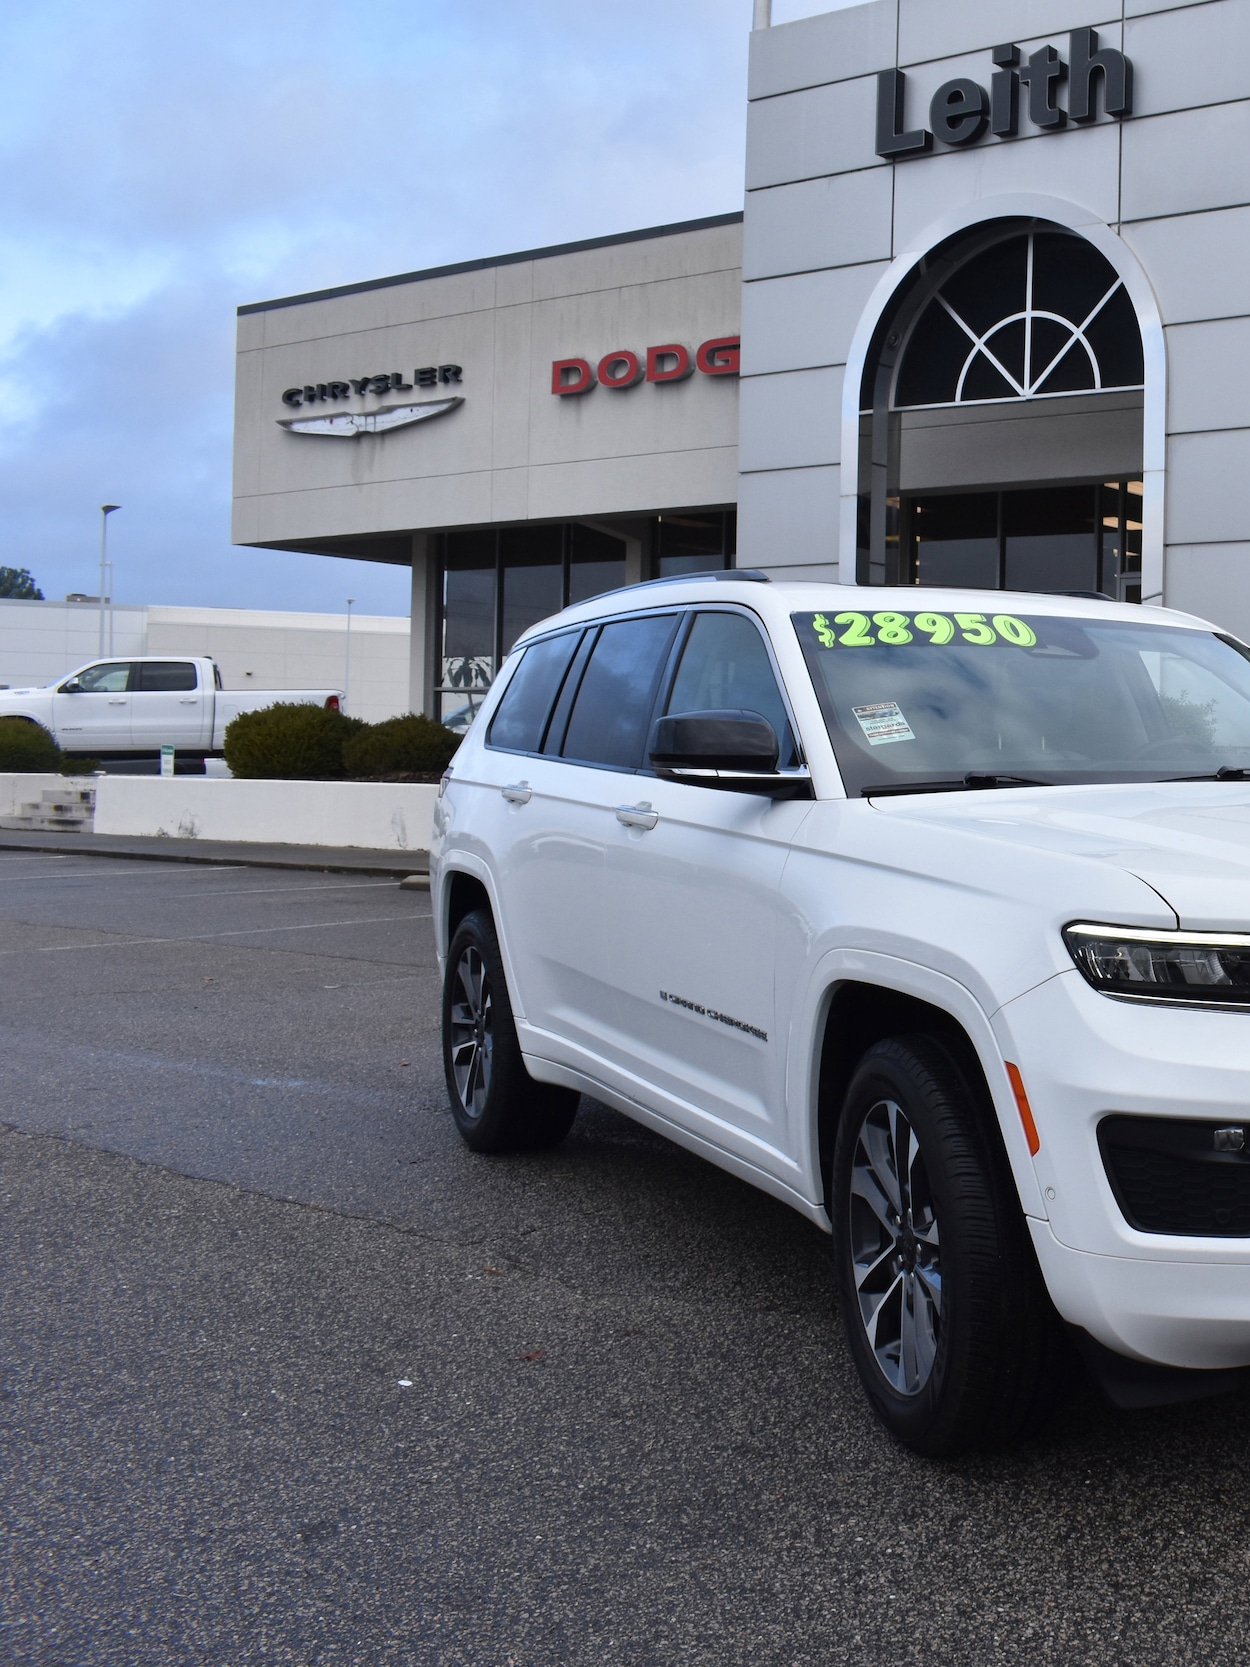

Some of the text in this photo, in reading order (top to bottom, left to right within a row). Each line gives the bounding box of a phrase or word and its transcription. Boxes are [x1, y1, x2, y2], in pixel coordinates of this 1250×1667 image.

[875, 27, 1133, 158] Leith
[282, 364, 462, 406] CHRYSLER
[813, 611, 1037, 648] $28950
